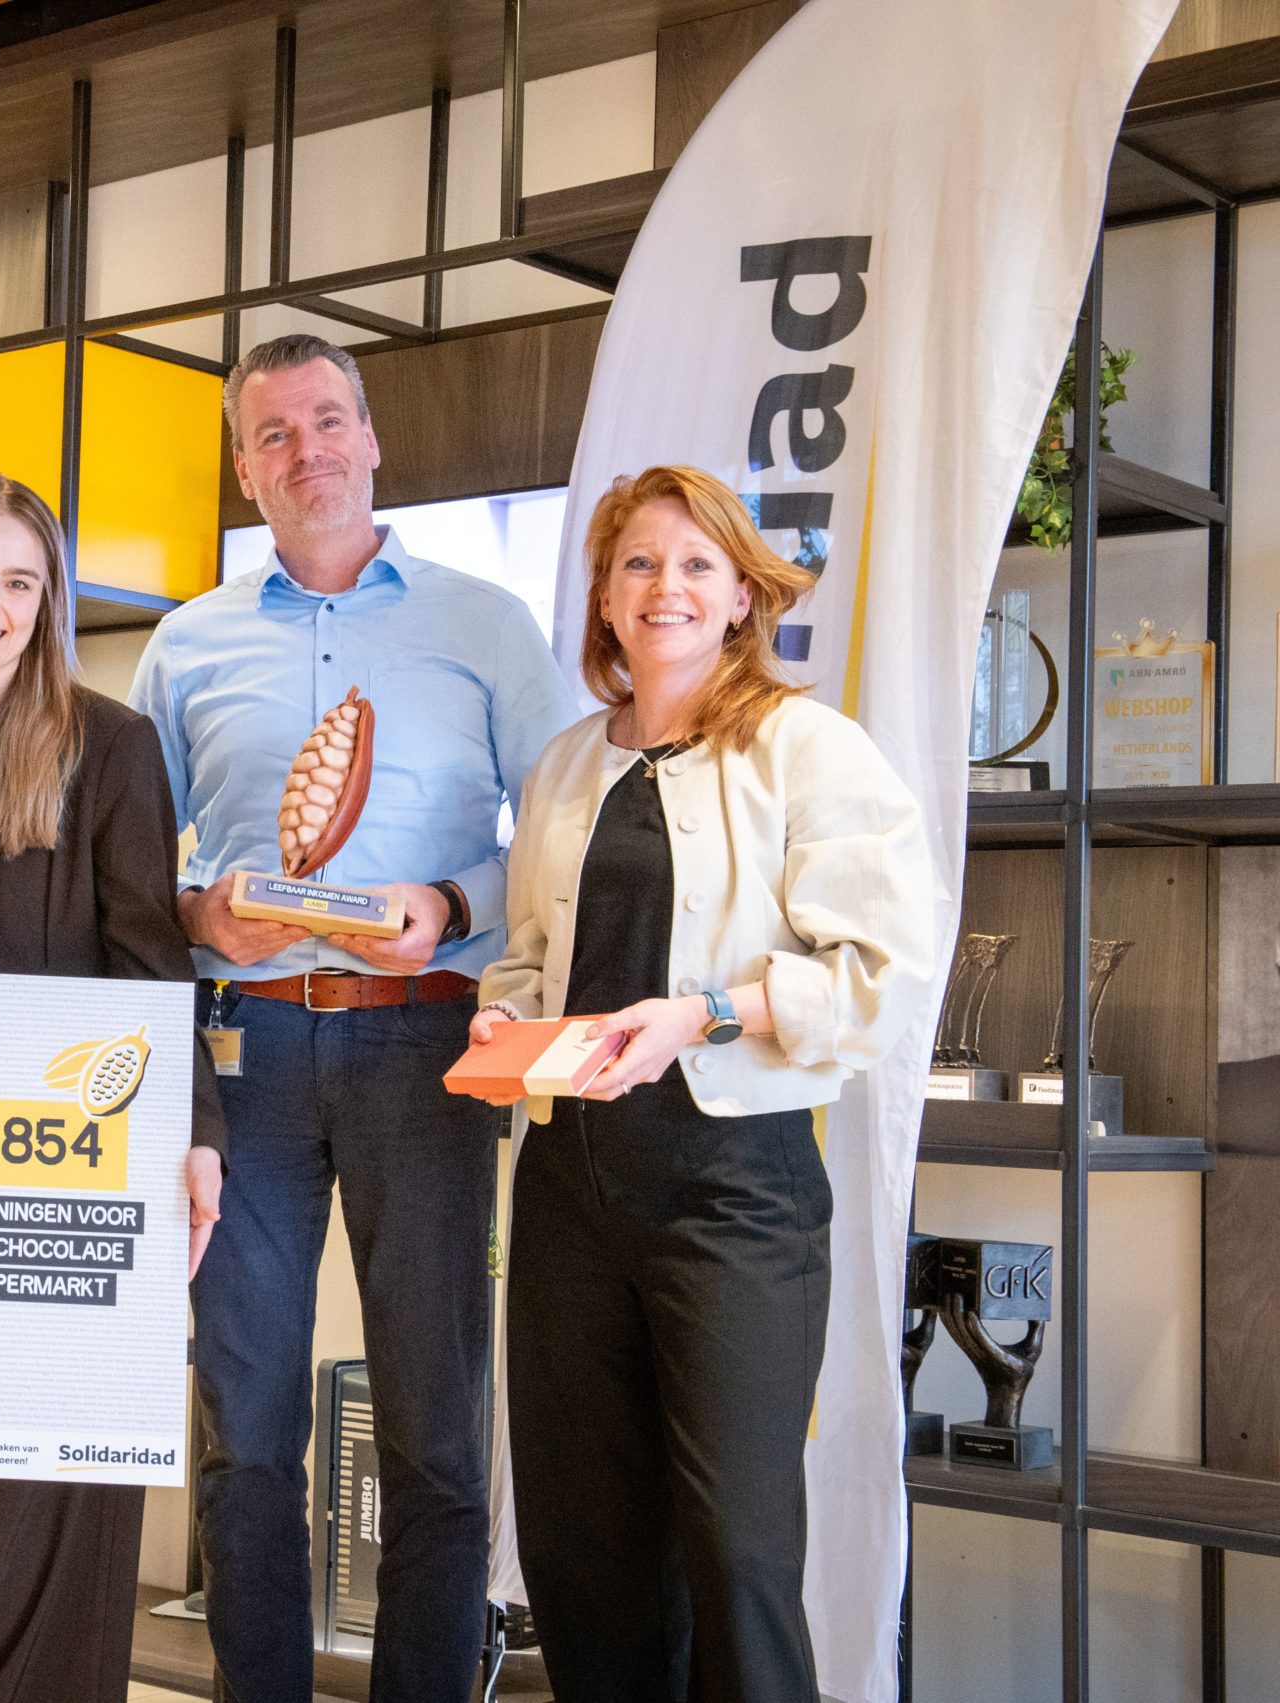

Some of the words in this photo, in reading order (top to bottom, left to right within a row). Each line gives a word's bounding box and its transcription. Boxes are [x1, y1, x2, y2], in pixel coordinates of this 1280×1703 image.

[1103, 697, 1193, 718] WEBSHOP
[1113, 742, 1193, 755] NETHERLANDS
[268, 882, 307, 896] LEEFBAAR
[307, 889, 340, 901] INKOMEN
[341, 894, 369, 905] AWARD
[77, 1205, 137, 1227] VOOR
[58, 1444, 175, 1466] Solidaridad
[360, 1476, 374, 1543] JUMBO
